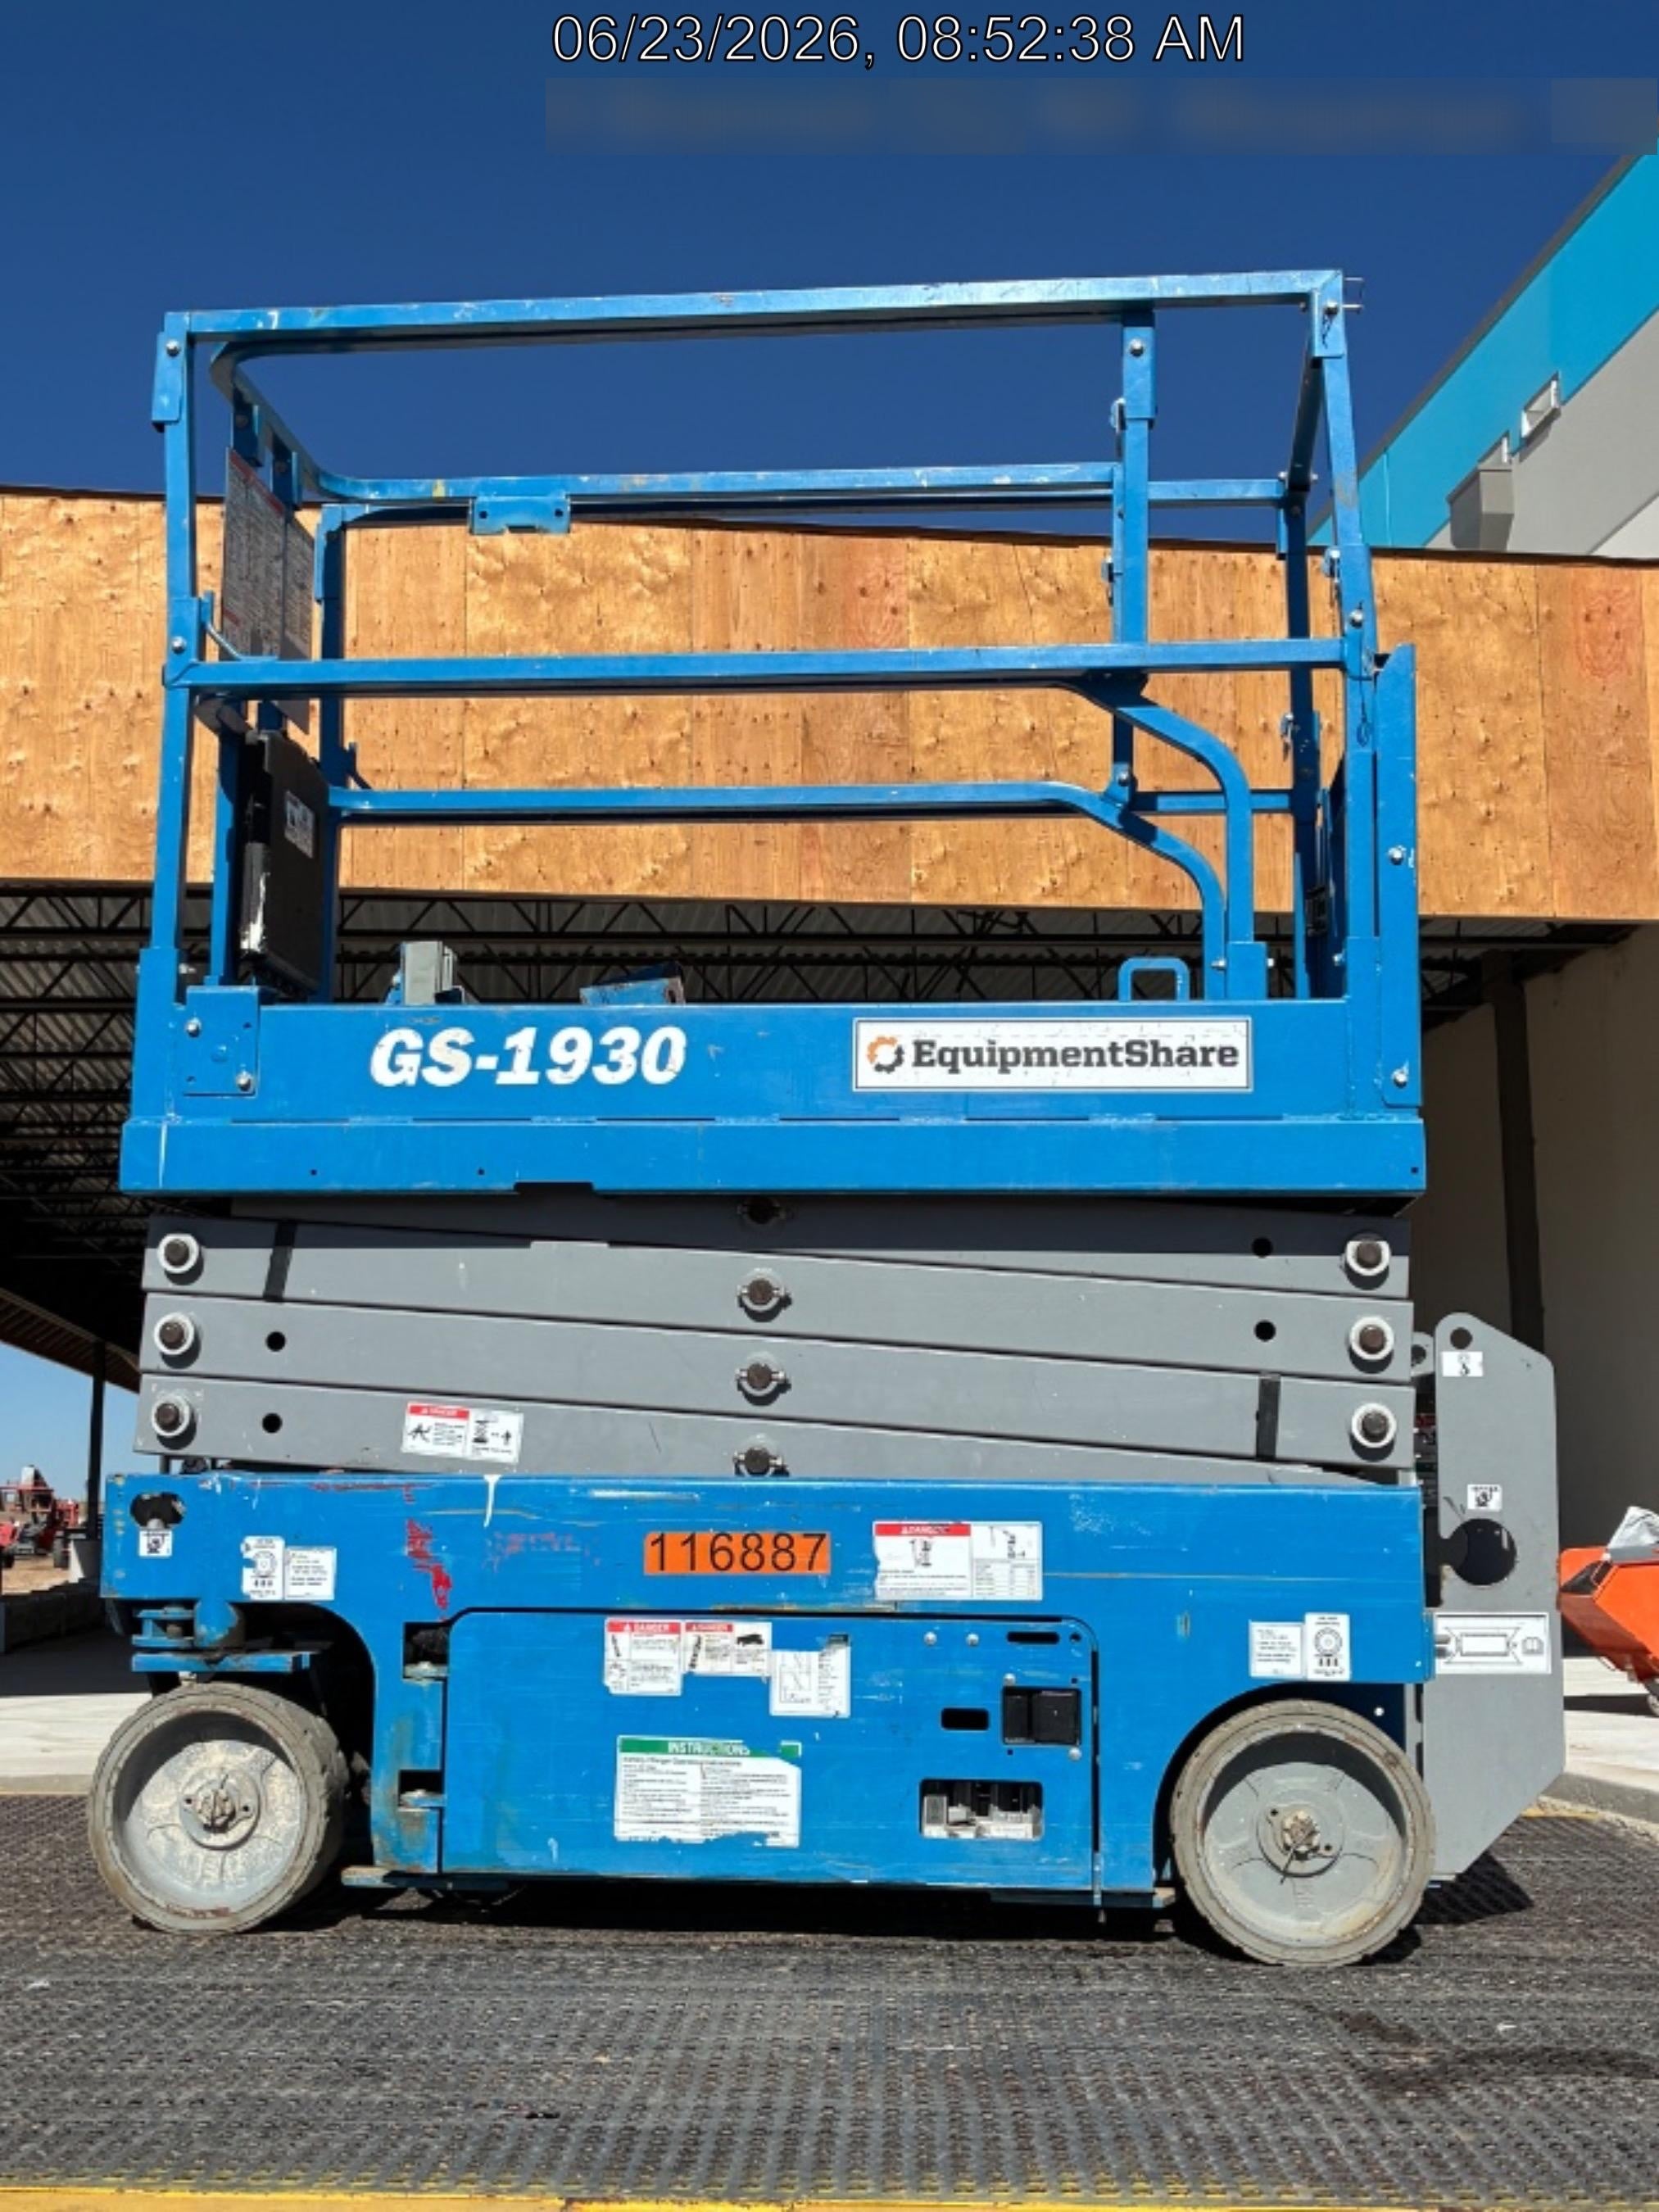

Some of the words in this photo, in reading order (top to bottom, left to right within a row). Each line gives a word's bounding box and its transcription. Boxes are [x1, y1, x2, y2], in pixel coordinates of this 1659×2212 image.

[370, 1026, 687, 1086] GS-1930
[911, 1038, 1240, 1074] EquipmentShare
[650, 1532, 827, 1572] 116887
